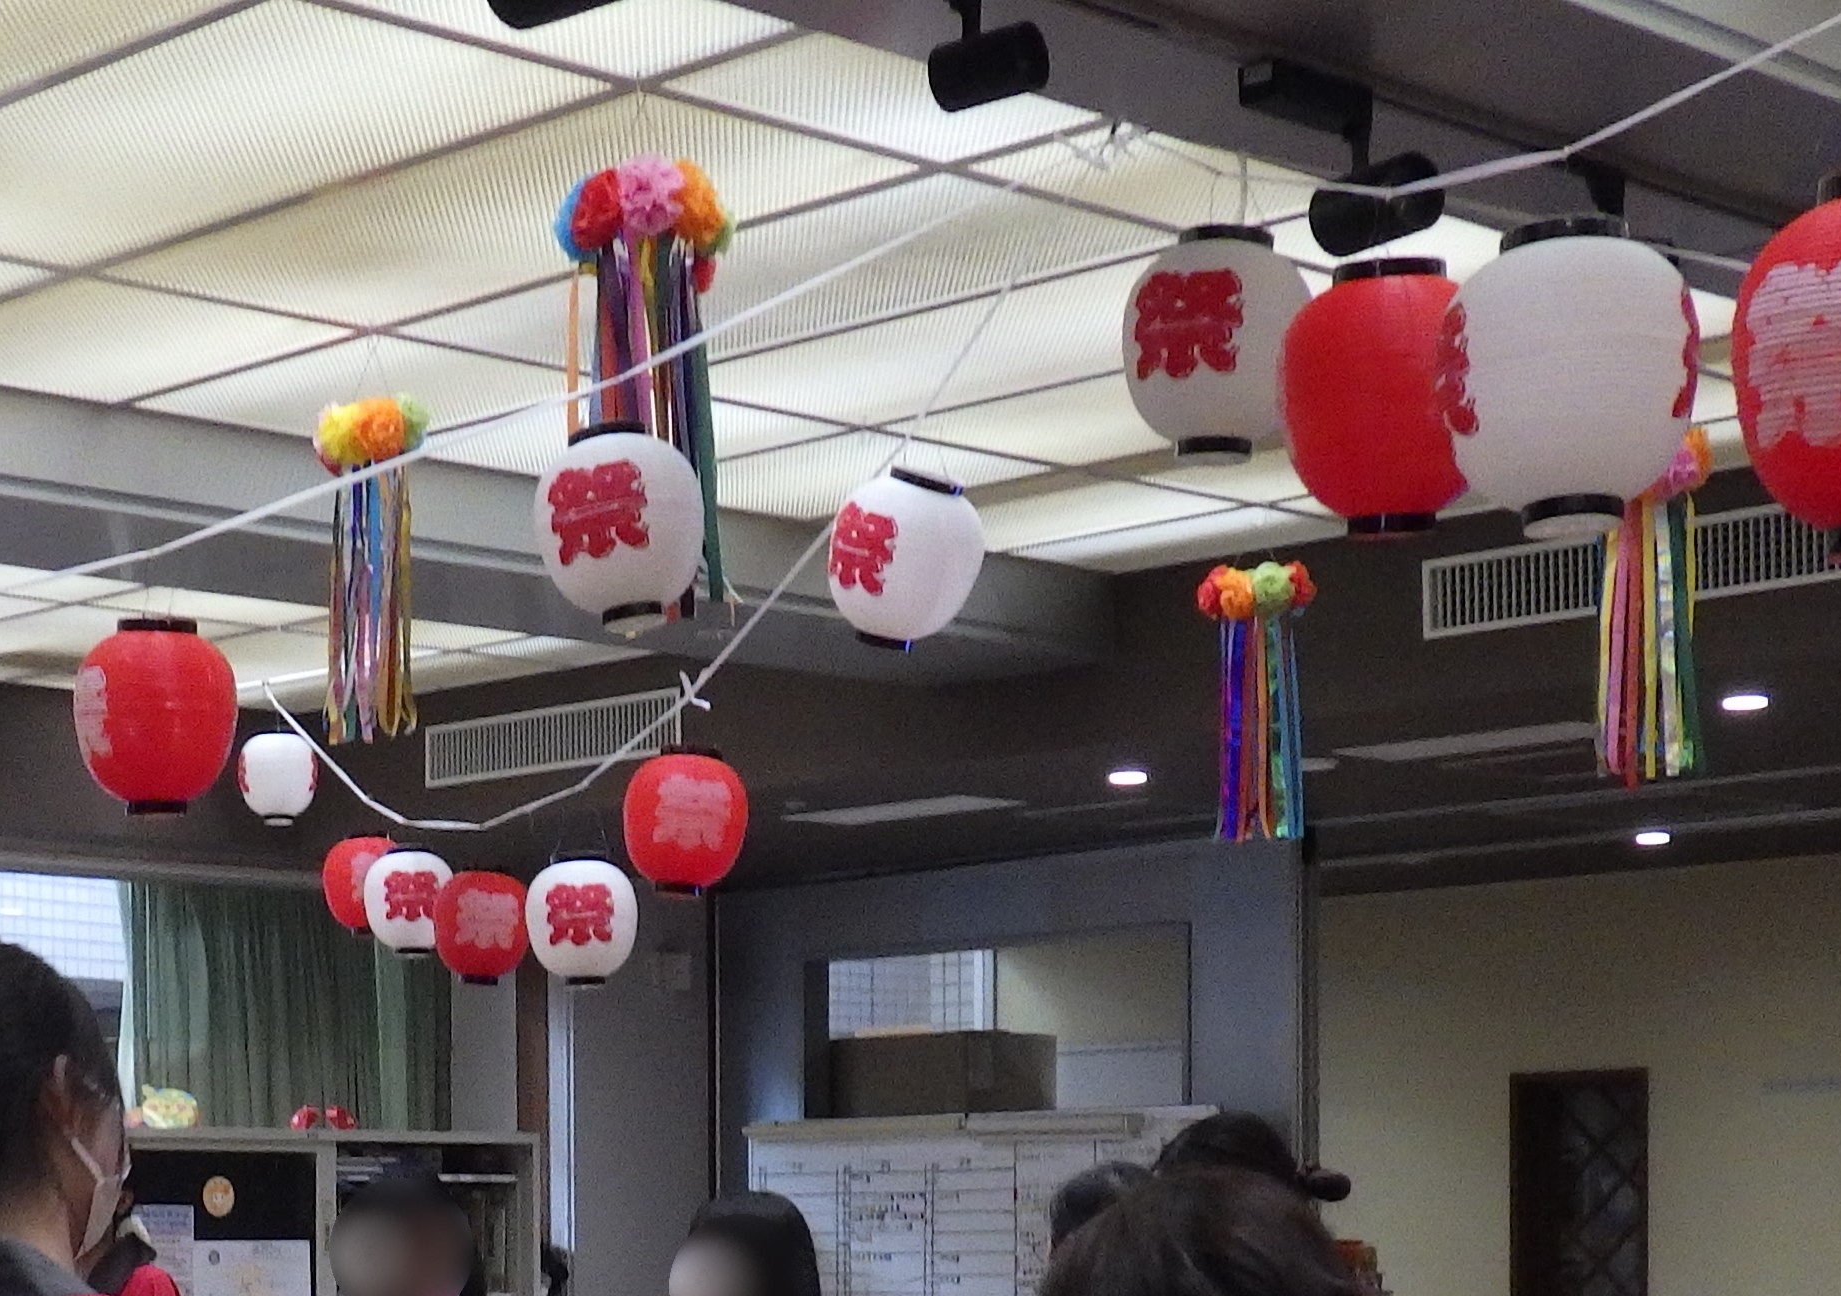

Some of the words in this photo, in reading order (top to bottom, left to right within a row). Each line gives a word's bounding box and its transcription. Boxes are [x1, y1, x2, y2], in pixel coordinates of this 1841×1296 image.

[1135, 268, 1245, 380] 祭
[548, 459, 649, 566] 祭
[830, 502, 899, 596] 祭
[653, 774, 732, 851] 祭
[384, 871, 440, 921] 祭
[455, 888, 518, 949] 祭
[546, 883, 614, 945] 祭
